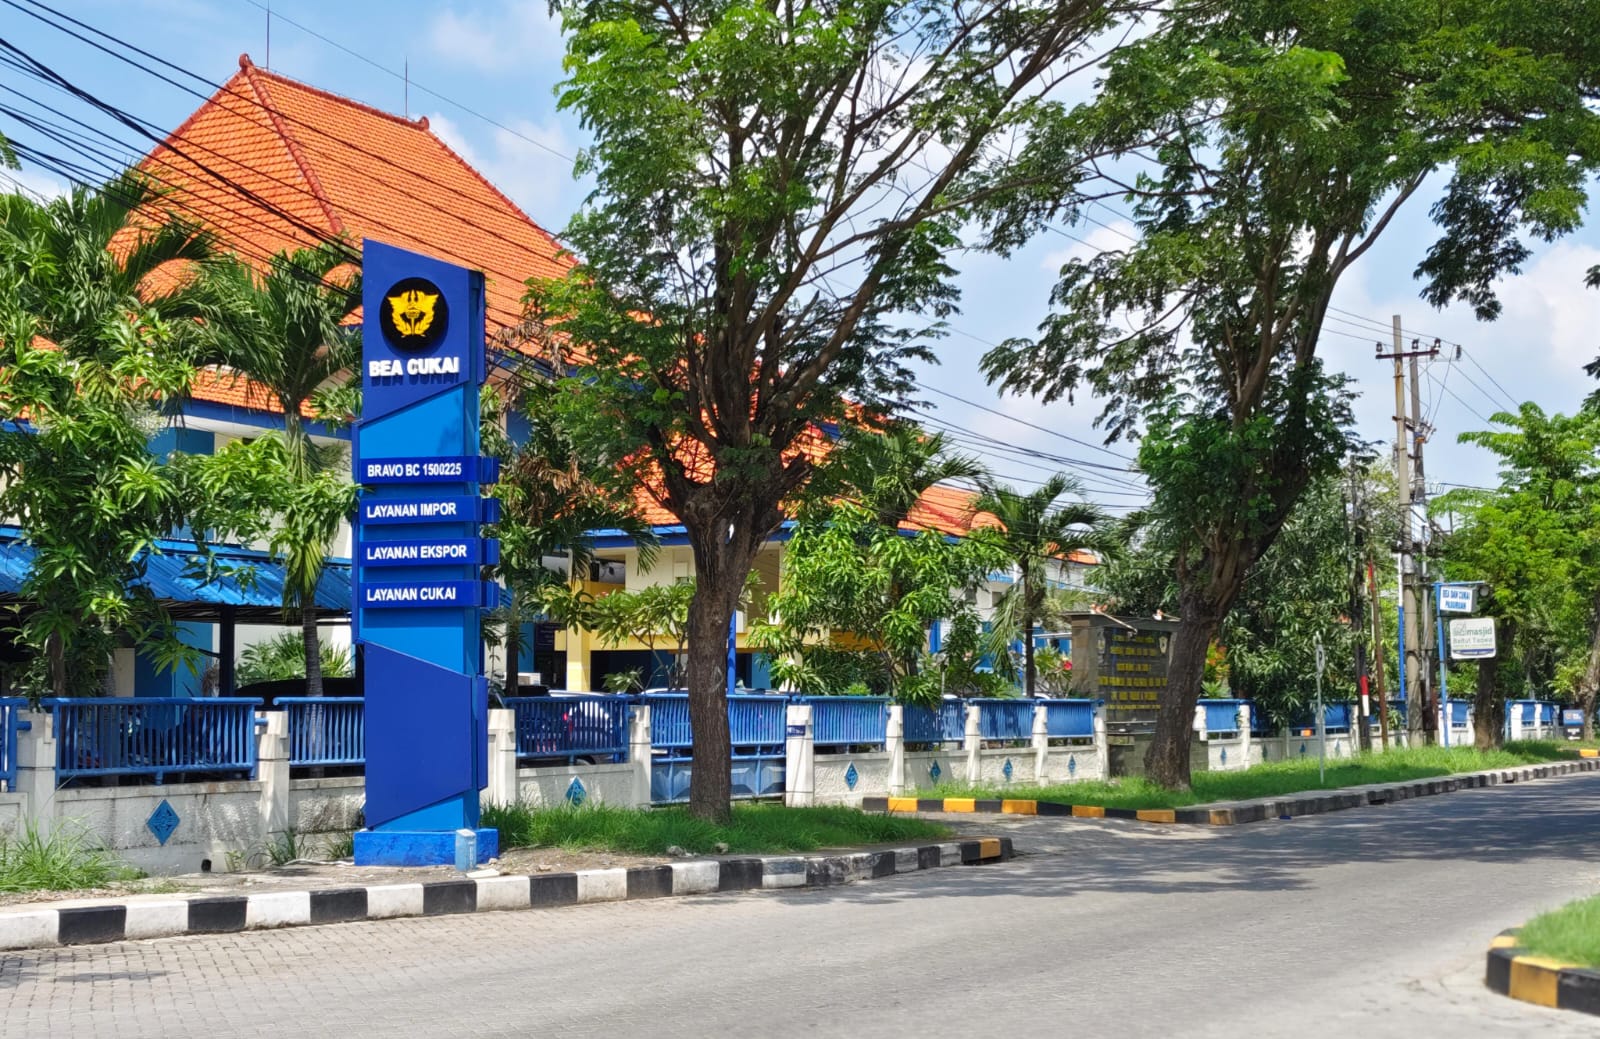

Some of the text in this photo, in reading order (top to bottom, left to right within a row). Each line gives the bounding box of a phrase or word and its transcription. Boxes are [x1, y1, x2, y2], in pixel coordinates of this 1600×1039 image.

[369, 356, 460, 377] BEA CUKAI
[367, 462, 462, 477] BRAVO BC 1500225
[367, 502, 457, 518] LAYANAN IMPOR
[367, 544, 467, 560] LAYANAN EKSPOR
[367, 586, 456, 602] LAYANAN CUKAI
[1466, 626, 1493, 637] masjid
